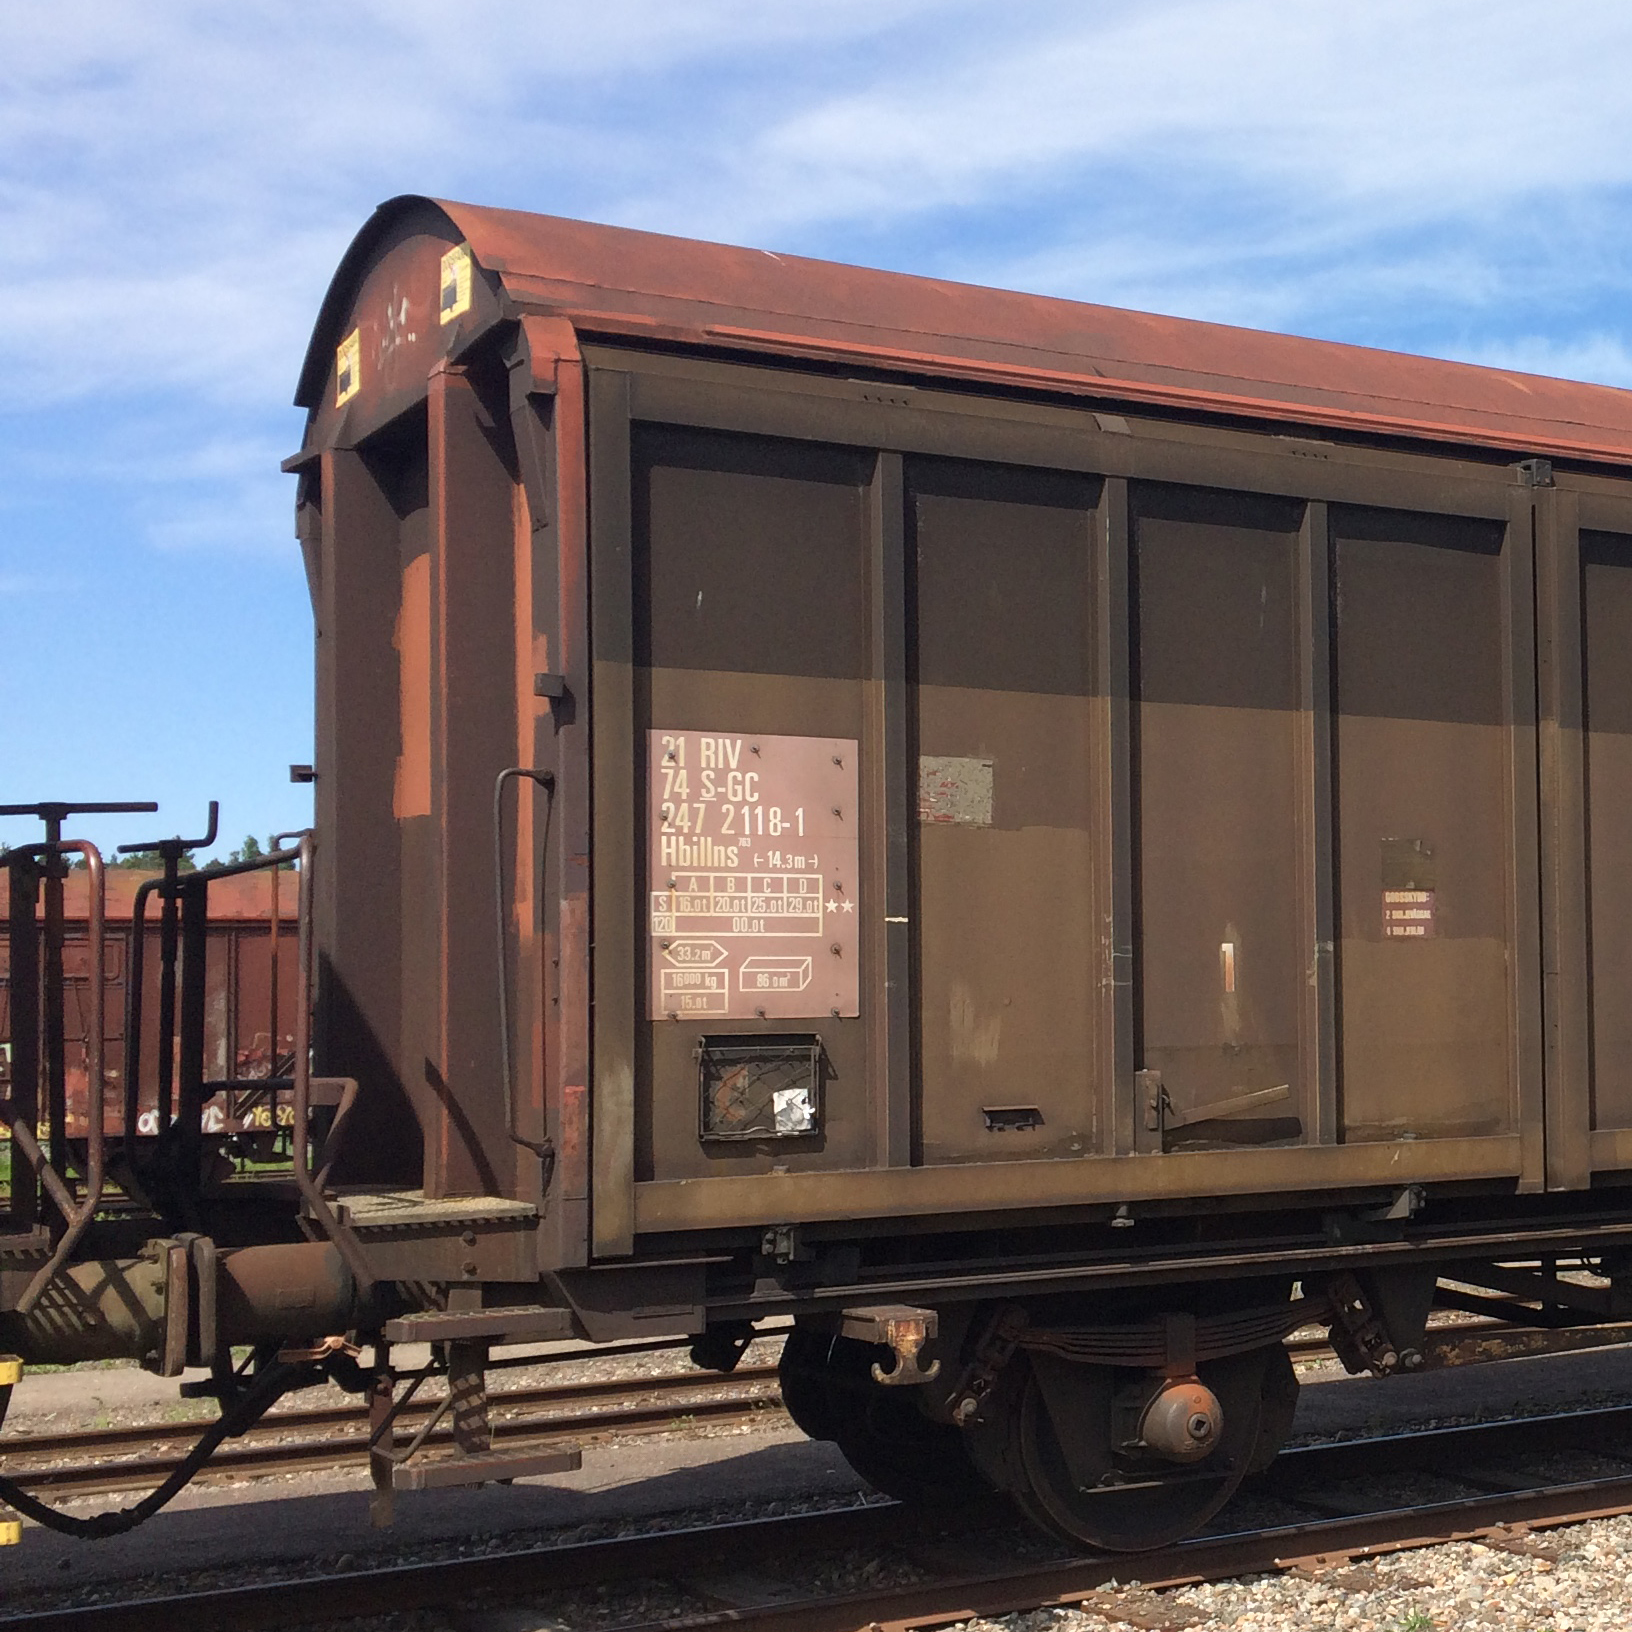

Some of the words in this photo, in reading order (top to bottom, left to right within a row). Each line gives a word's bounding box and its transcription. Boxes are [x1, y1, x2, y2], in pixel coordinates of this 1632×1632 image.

[661, 736, 685, 767] 21
[700, 738, 742, 769] RIV
[661, 769, 689, 800] 74
[700, 770, 759, 803] S-GC
[661, 803, 705, 834] 247
[721, 804, 805, 837] 2118-1
[661, 836, 739, 868] Hbillns
[688, 877, 698, 893] A
[727, 878, 735, 893] B
[763, 878, 771, 894] C
[799, 878, 807, 894] D
[658, 897, 667, 912] S
[1385, 910, 1391, 920] 2
[653, 917, 672, 933] 120
[1221, 943, 1235, 992] 1
[704, 973, 717, 990] kg
[756, 973, 770, 988] 86
